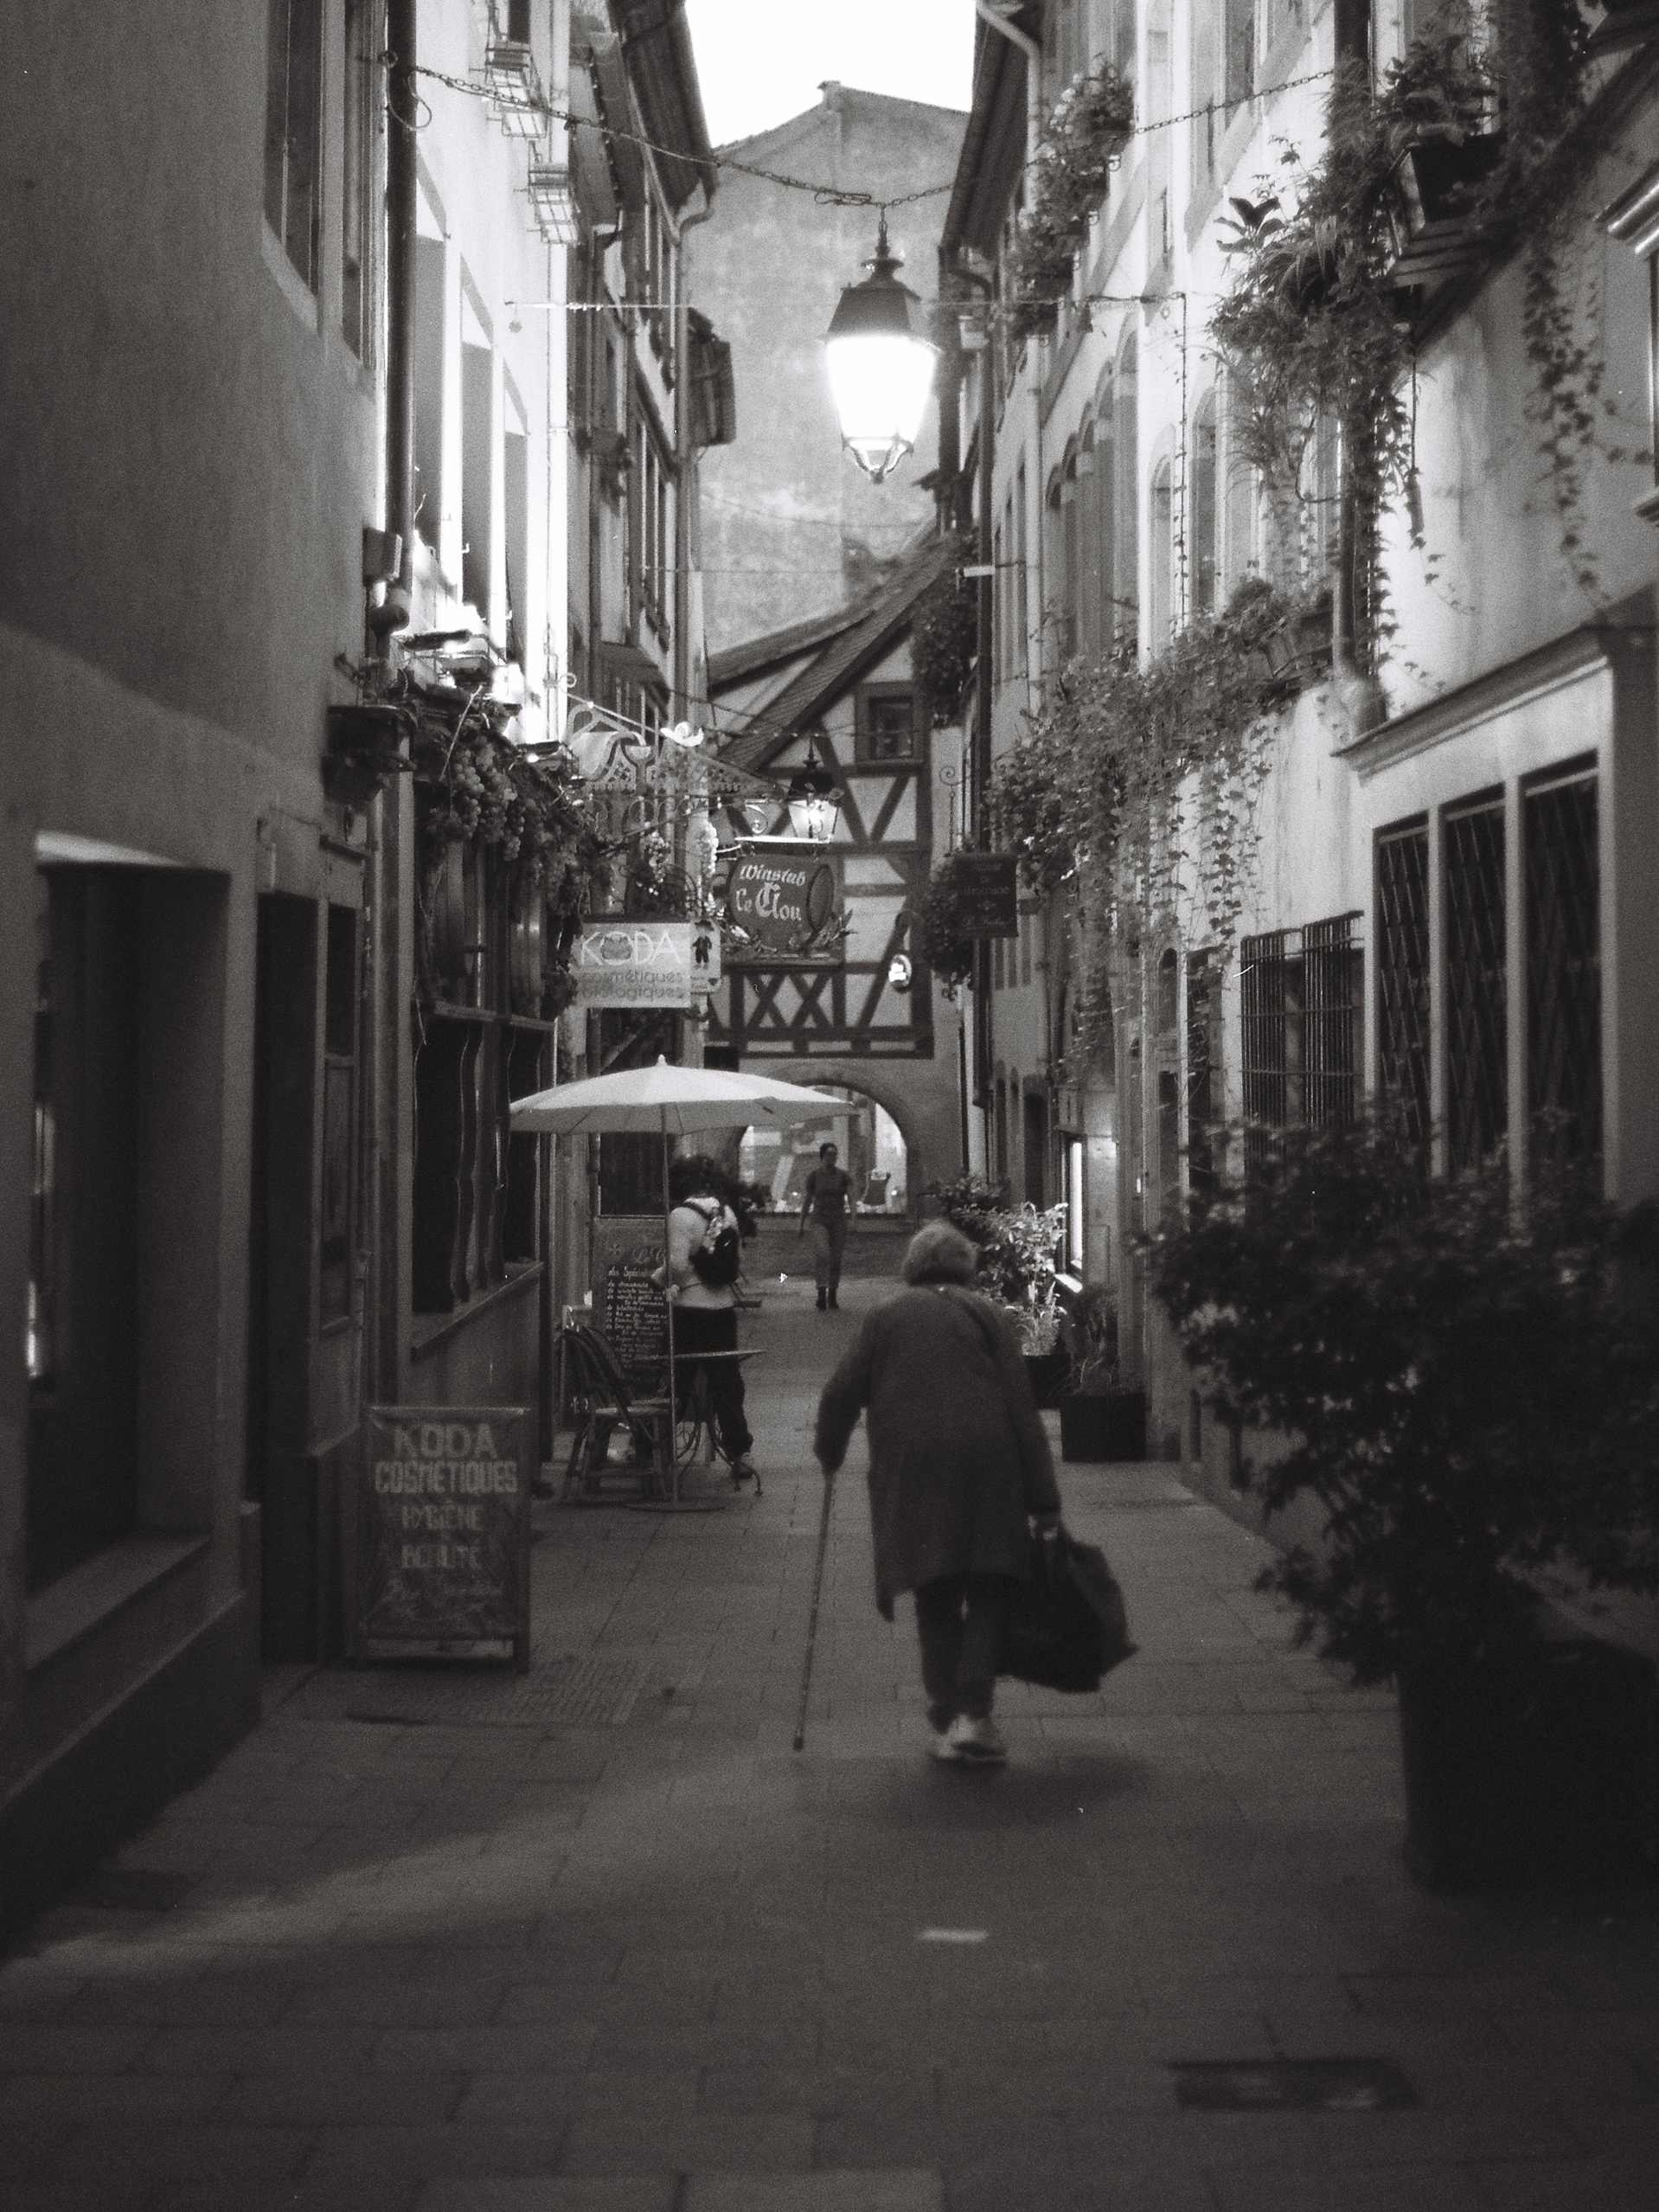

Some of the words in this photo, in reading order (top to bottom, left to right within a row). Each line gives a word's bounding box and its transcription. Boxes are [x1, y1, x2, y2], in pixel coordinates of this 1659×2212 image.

[755, 882, 802, 922] Clou
[580, 930, 682, 965] KODA
[582, 985, 682, 1001] biologiques
[394, 1422, 497, 1459] KODA
[374, 1459, 518, 1496] COSMETIQUES
